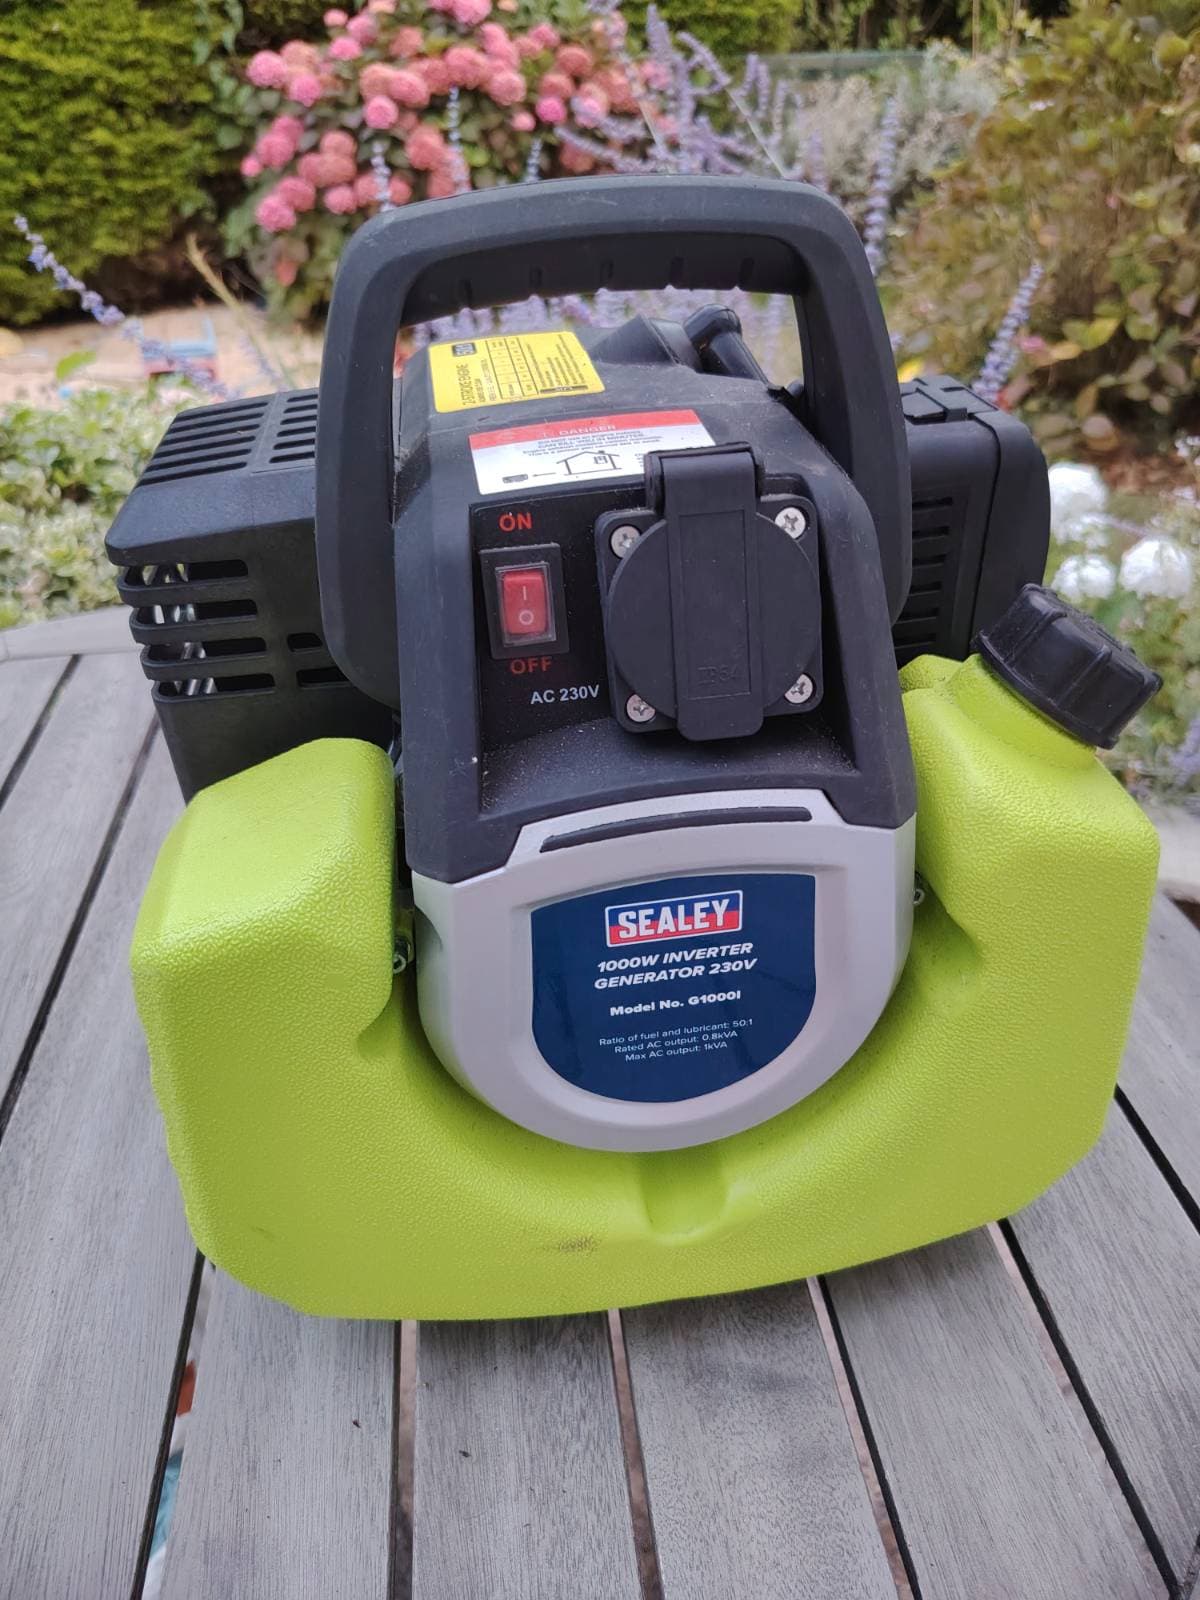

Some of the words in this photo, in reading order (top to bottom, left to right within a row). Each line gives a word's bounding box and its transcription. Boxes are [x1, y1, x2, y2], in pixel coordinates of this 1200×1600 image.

[559, 424, 617, 436] DANGER
[498, 511, 533, 533] ON
[510, 657, 552, 675] OFF
[530, 689, 556, 705] AC
[559, 684, 600, 702] 230V
[617, 898, 731, 939] SEALEY
[596, 954, 661, 973] 1000W
[662, 942, 754, 965] INVERTER
[593, 966, 706, 990] GENERATOR
[708, 958, 758, 976] 230V
[610, 1002, 656, 1017] Model
[659, 999, 685, 1010] No.
[599, 1036, 625, 1046] Ratio
[627, 1033, 638, 1042] of
[640, 1030, 660, 1040] fuel
[661, 1028, 682, 1038] and
[683, 1021, 729, 1034] lubricant:
[732, 1018, 754, 1029] 50:1
[614, 1043, 645, 1054] Rated
[646, 1040, 663, 1050] AC
[664, 1035, 700, 1049] output:
[702, 1029, 739, 1042] 0.8kVA
[625, 1051, 647, 1062] Max
[648, 1048, 664, 1058] AC
[666, 1044, 702, 1058] output:
[704, 1041, 728, 1052] 1kVA
